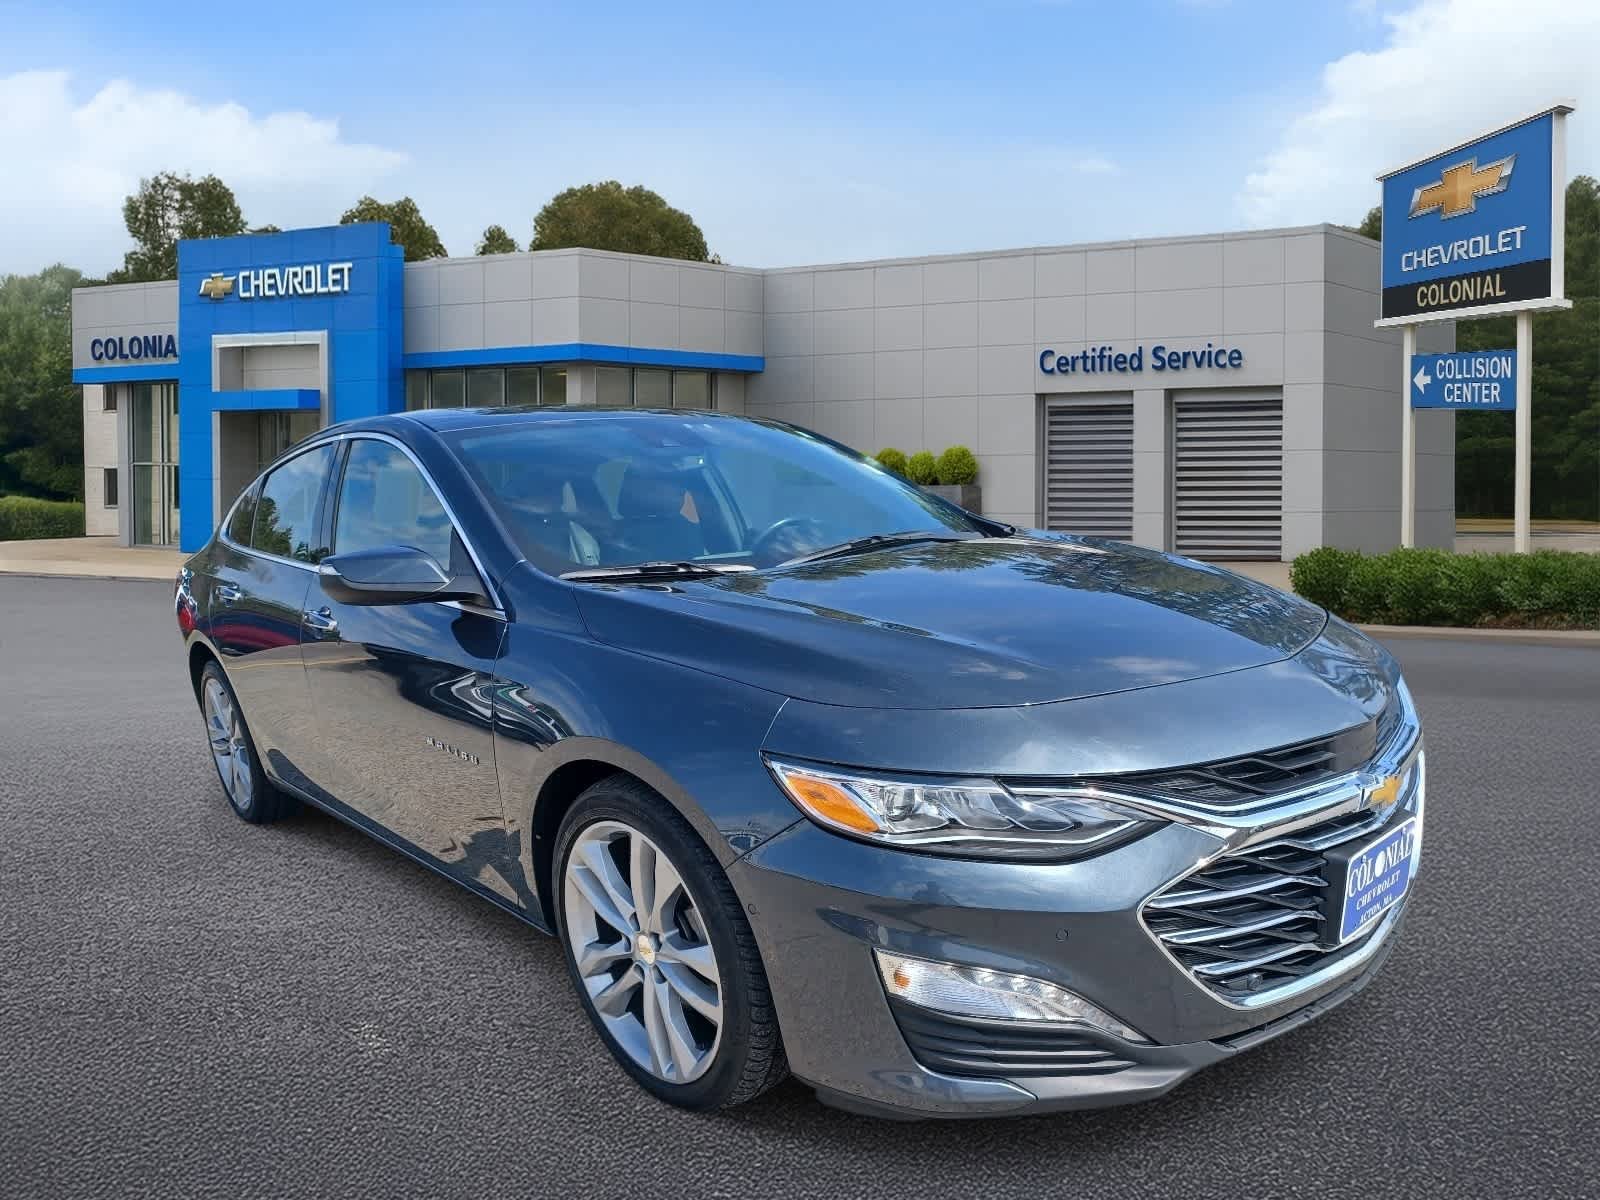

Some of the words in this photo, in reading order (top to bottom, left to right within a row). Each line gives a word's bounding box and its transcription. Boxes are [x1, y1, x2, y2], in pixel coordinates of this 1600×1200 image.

[1401, 225, 1527, 272] CHEVROLET
[239, 262, 352, 298] CHEVROLET
[1416, 273, 1506, 307] COLONIAL
[91, 334, 179, 361] COLONIA
[1039, 346, 1143, 375] Certified
[1151, 343, 1243, 371] Service
[1436, 356, 1512, 380] COLLISION
[1444, 382, 1501, 403] CENTER
[1348, 830, 1414, 898] COLONIAL
[1356, 869, 1401, 911] CHEVROLET
